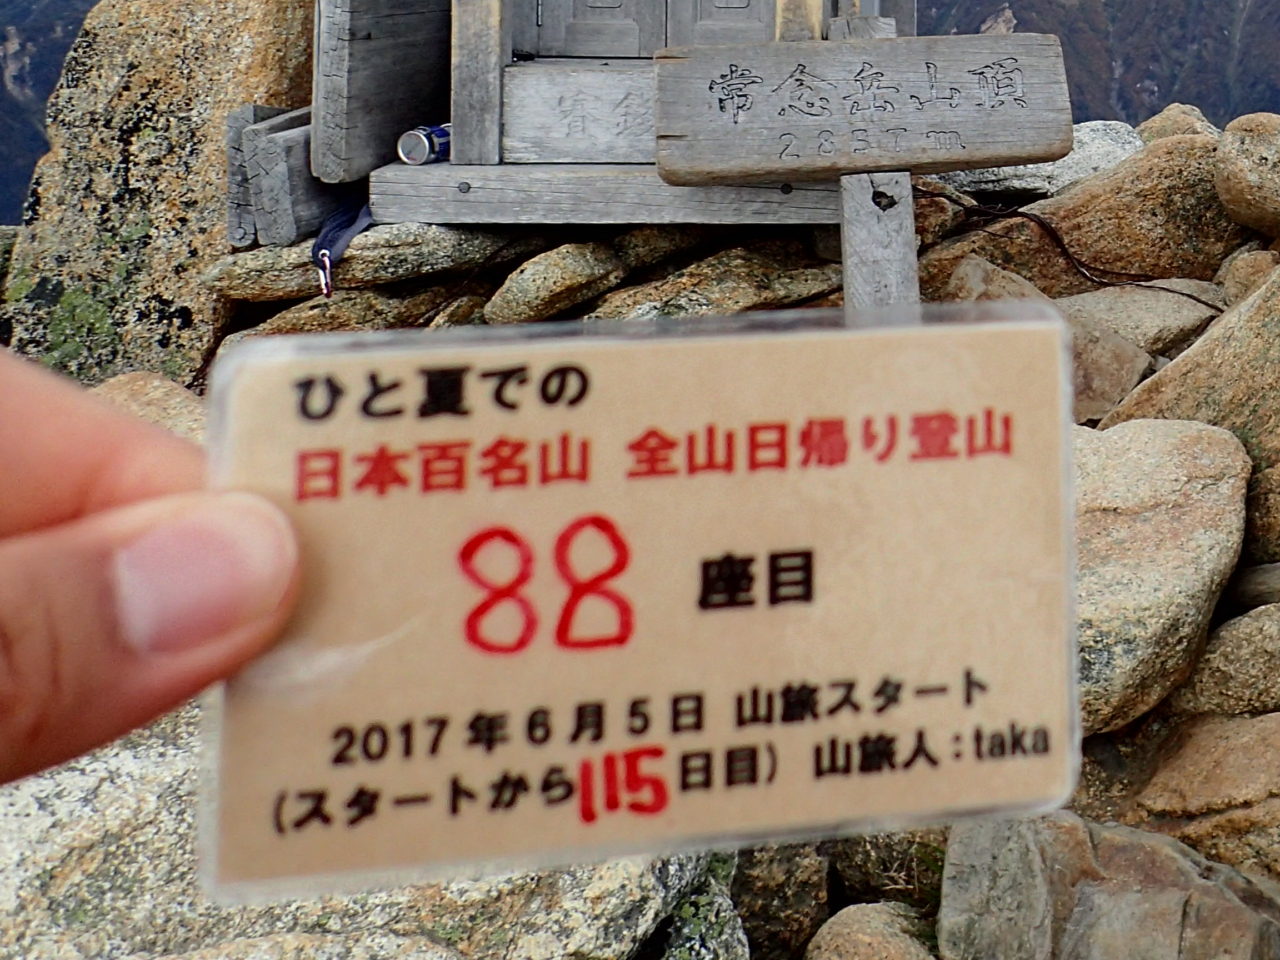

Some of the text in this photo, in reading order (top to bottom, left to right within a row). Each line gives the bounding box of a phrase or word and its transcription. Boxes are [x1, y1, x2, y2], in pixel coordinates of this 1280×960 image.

[708, 57, 1028, 124] 常念岳山頂
[295, 363, 590, 420] ひと夏での
[294, 407, 1013, 500] 日本百名山 全山日帰り登山
[457, 513, 814, 655] 88 座目
[735, 668, 988, 728] 山旅スタート
